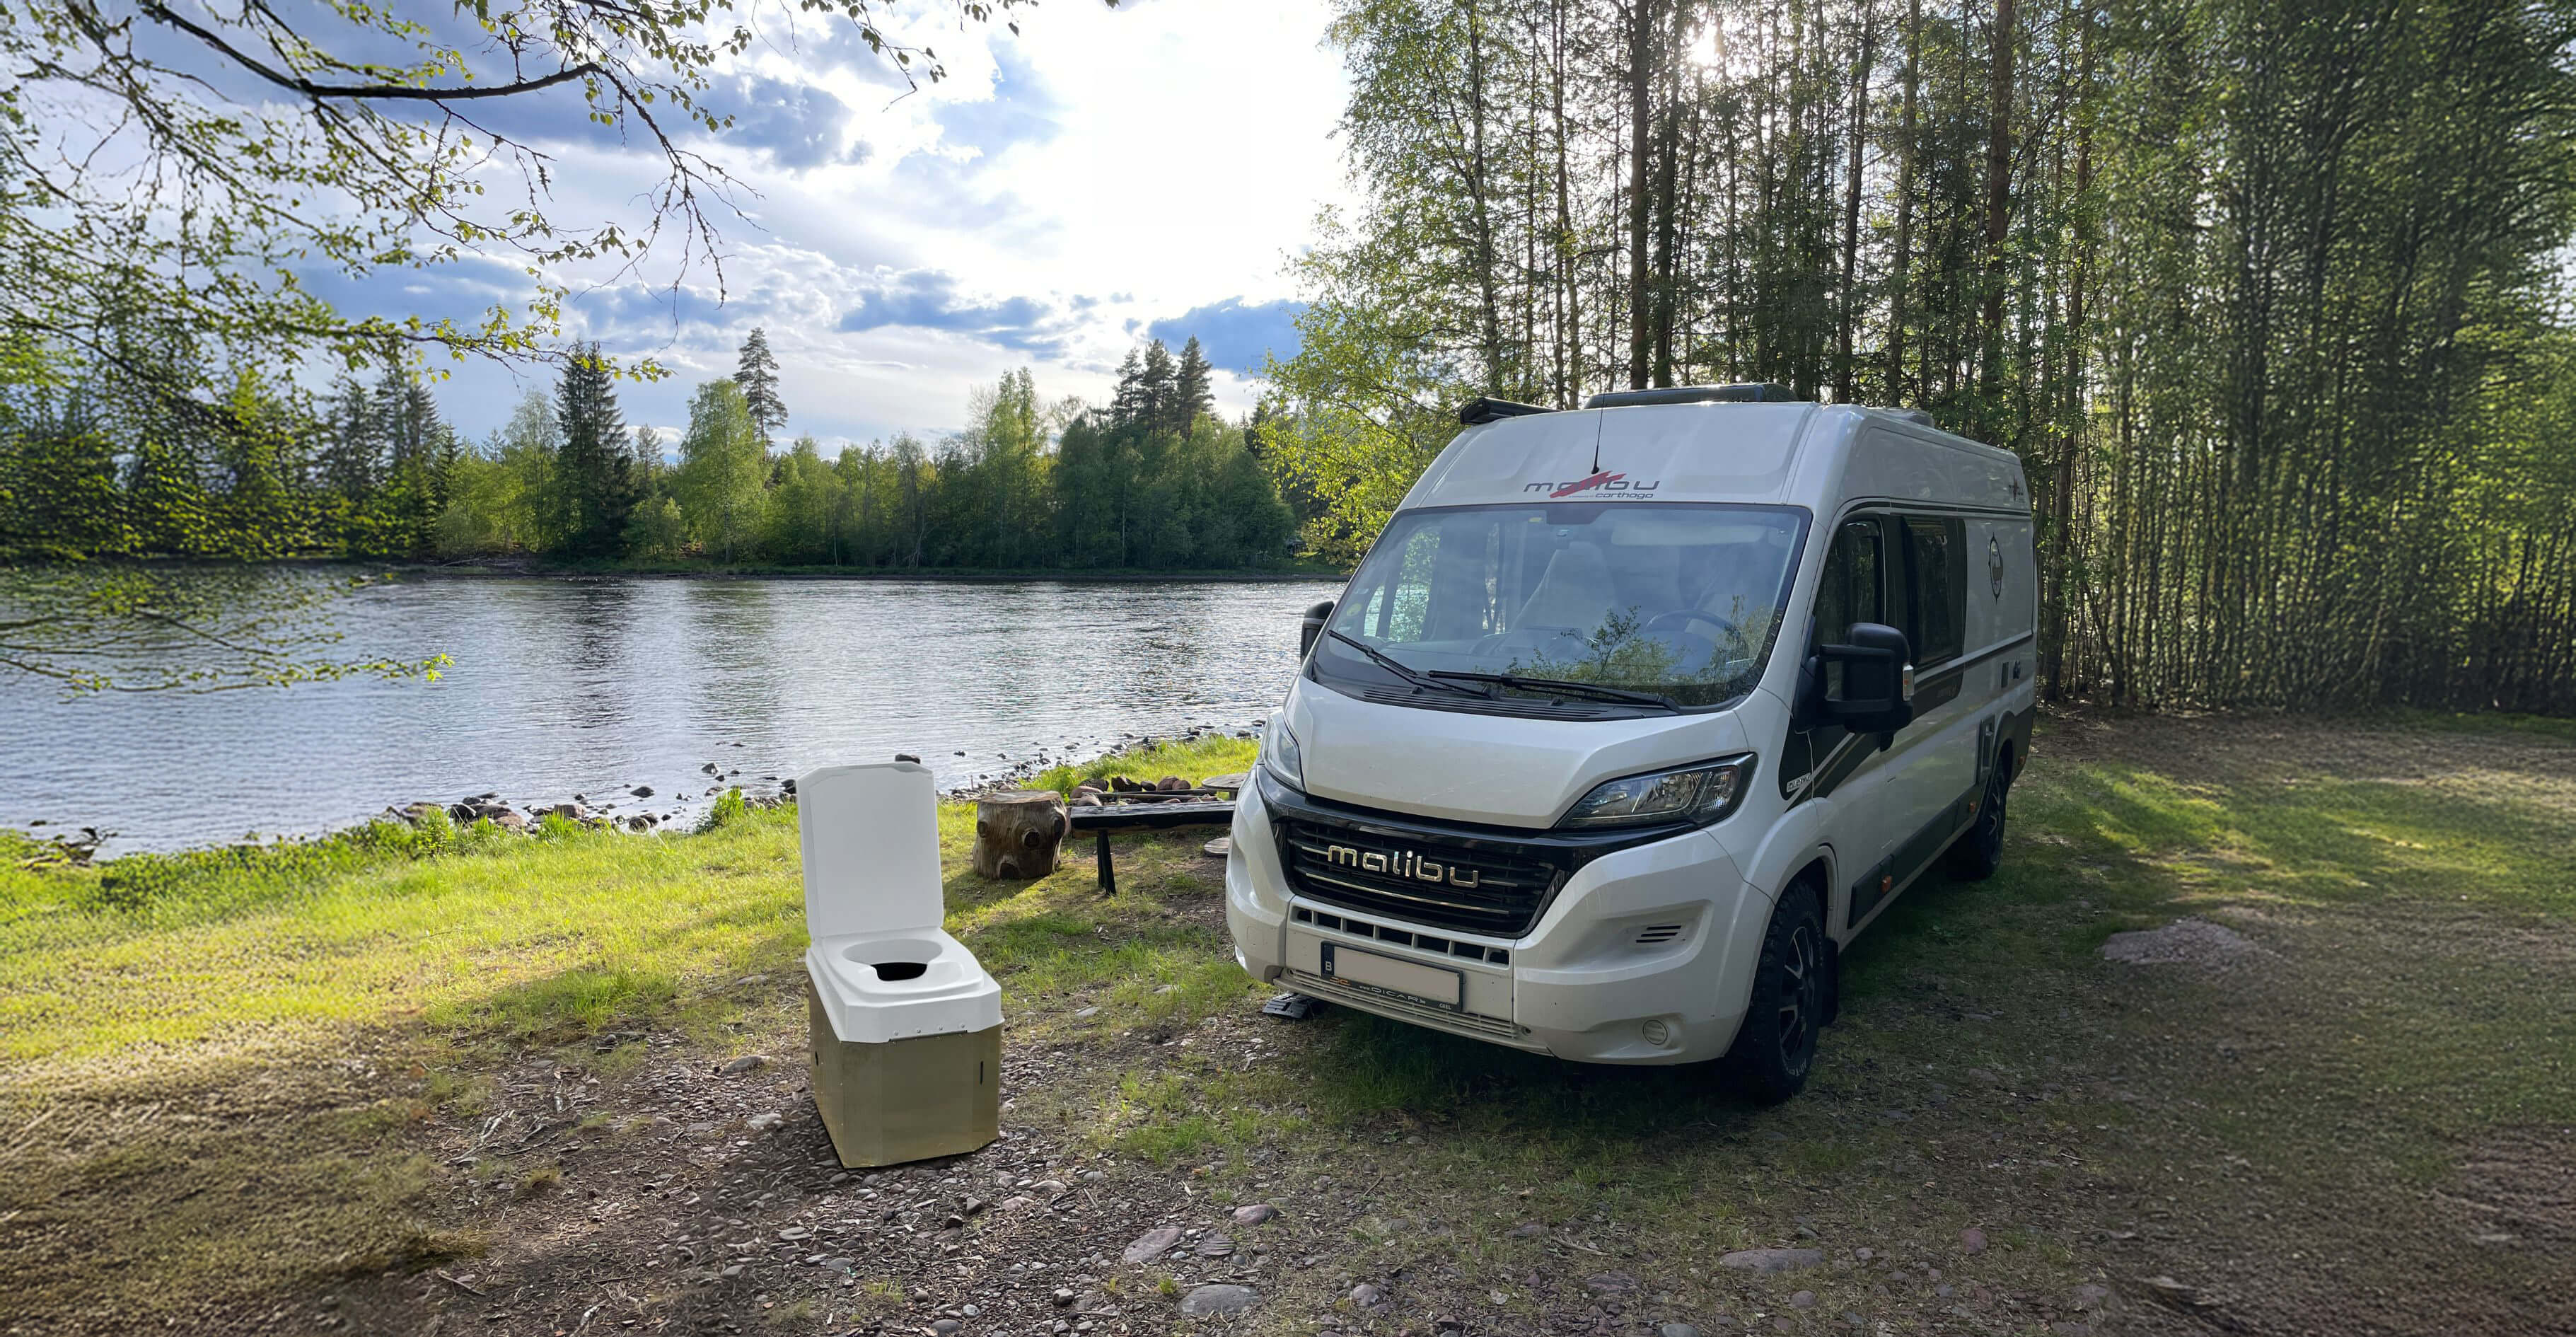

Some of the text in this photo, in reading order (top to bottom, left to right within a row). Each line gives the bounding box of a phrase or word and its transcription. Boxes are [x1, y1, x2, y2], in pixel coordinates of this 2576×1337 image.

[1595, 491, 1654, 499] carthago
[1328, 845, 1479, 889] malibu
[1325, 961, 1333, 972] B
